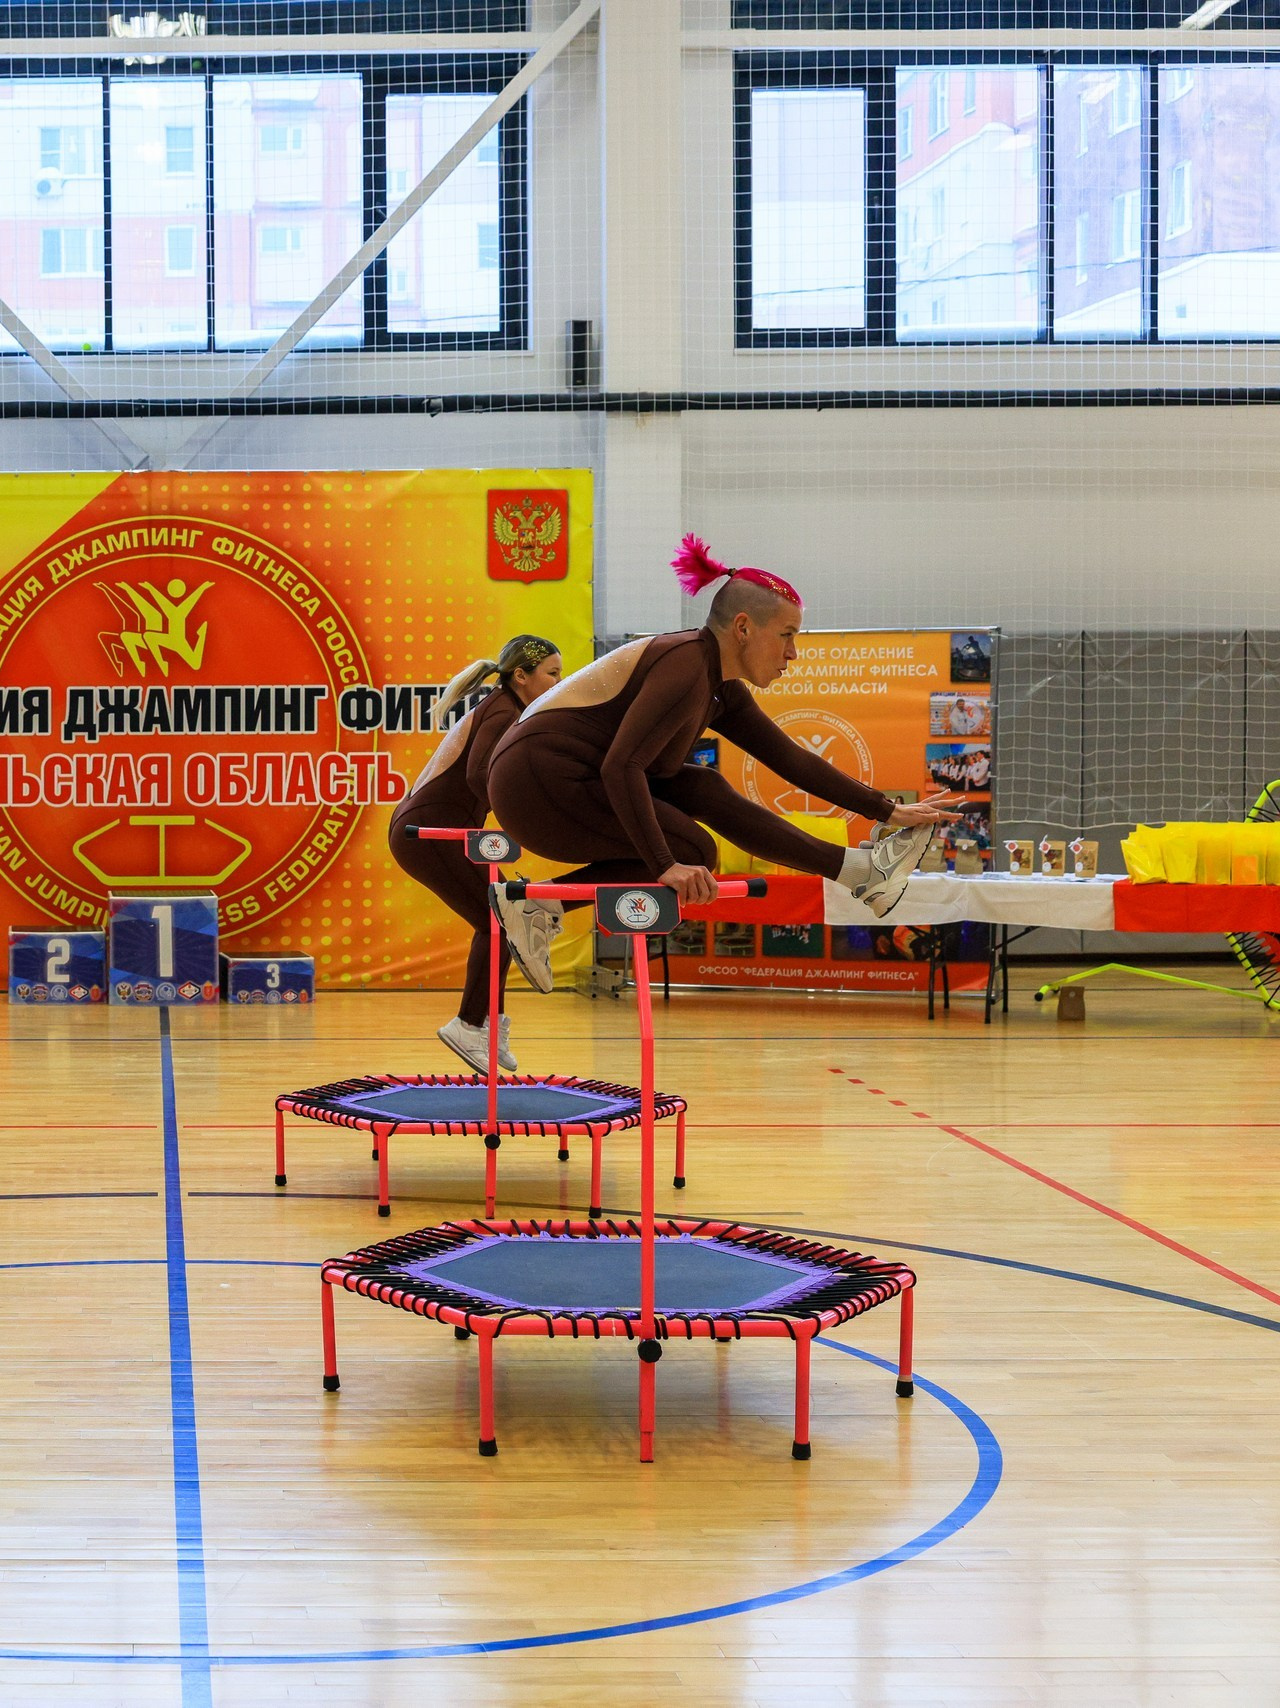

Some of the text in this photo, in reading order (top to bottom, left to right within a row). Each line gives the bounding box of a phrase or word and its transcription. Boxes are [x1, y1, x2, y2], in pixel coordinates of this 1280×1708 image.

[46, 527, 204, 585] ДЖАМПИНГ
[211, 537, 322, 617] ФИТНЕСА
[316, 615, 362, 688] РОСС
[830, 646, 914, 660] ОТДЕЛЕНИЕ
[869, 664, 938, 677] ФИТНЕСА
[823, 682, 888, 695] ОБЛАСТИ
[61, 685, 328, 743] ДЖАМПИНГ
[339, 684, 500, 734] ФИТН
[184, 752, 407, 807] ОБЛАСТЬ
[263, 772, 354, 902] FEDERAT
[47, 938, 70, 983] 2
[151, 905, 174, 978] 1
[266, 963, 280, 988] 3
[698, 965, 919, 981] ОФСОО "ФЕДЕРАЦИЯ ДЖАМПИНГ ФИТНЕСА"
